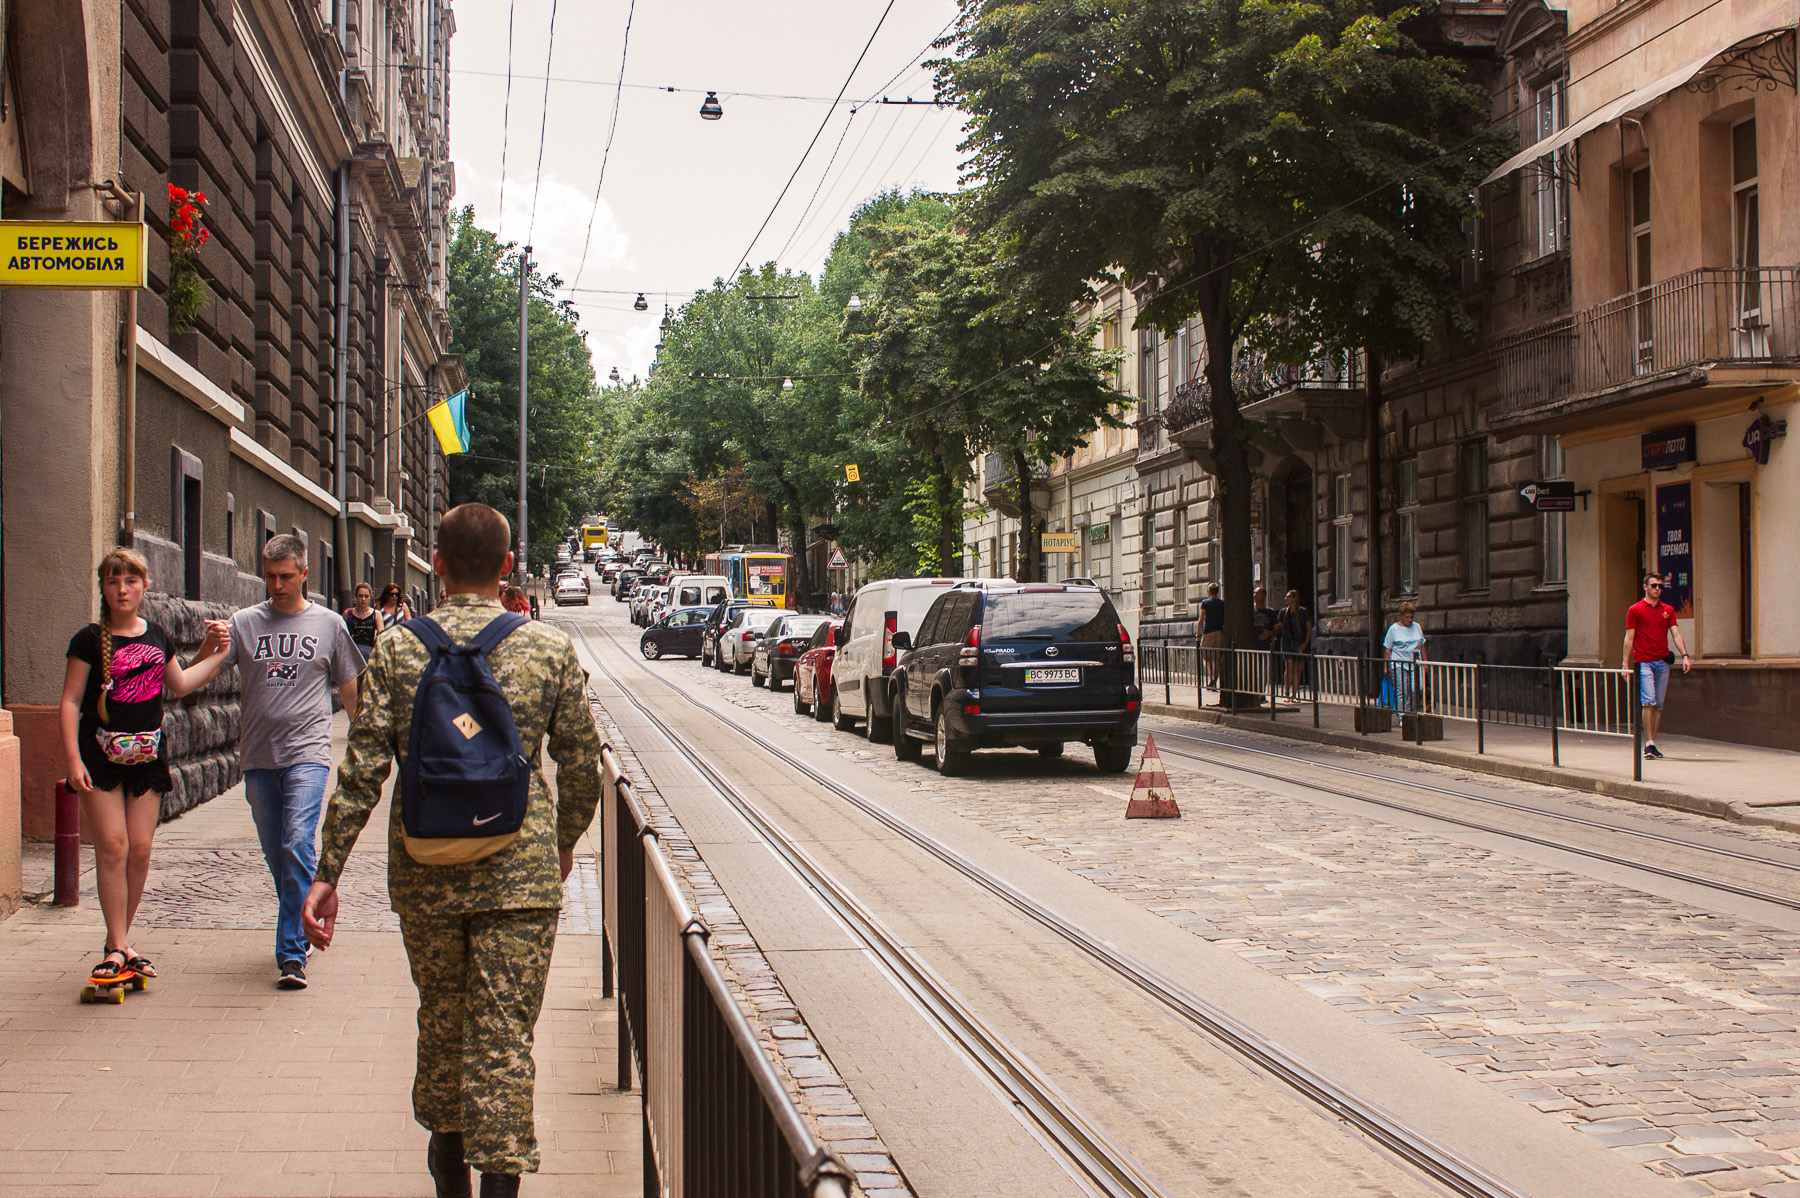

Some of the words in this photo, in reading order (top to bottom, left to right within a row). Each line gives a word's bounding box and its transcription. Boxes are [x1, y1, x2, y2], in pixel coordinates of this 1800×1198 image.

[18, 236, 118, 250] БЕРЕЖИСЬ
[8, 256, 124, 271] АВТОМОБІЛЯ
[1747, 429, 1760, 445] UA
[1643, 437, 1686, 458] СПОРТЛОТО
[1537, 487, 1550, 495] bet
[1043, 538, 1074, 547] НОТАРІУС
[1667, 529, 1682, 542] ТВОЯ
[1660, 542, 1689, 557] ПЕРЕМОГА
[764, 585, 770, 594] 2
[253, 633, 319, 661] AUS
[1030, 670, 1043, 679] BC
[1044, 670, 1063, 679] 9973
[1065, 669, 1077, 678] BC
